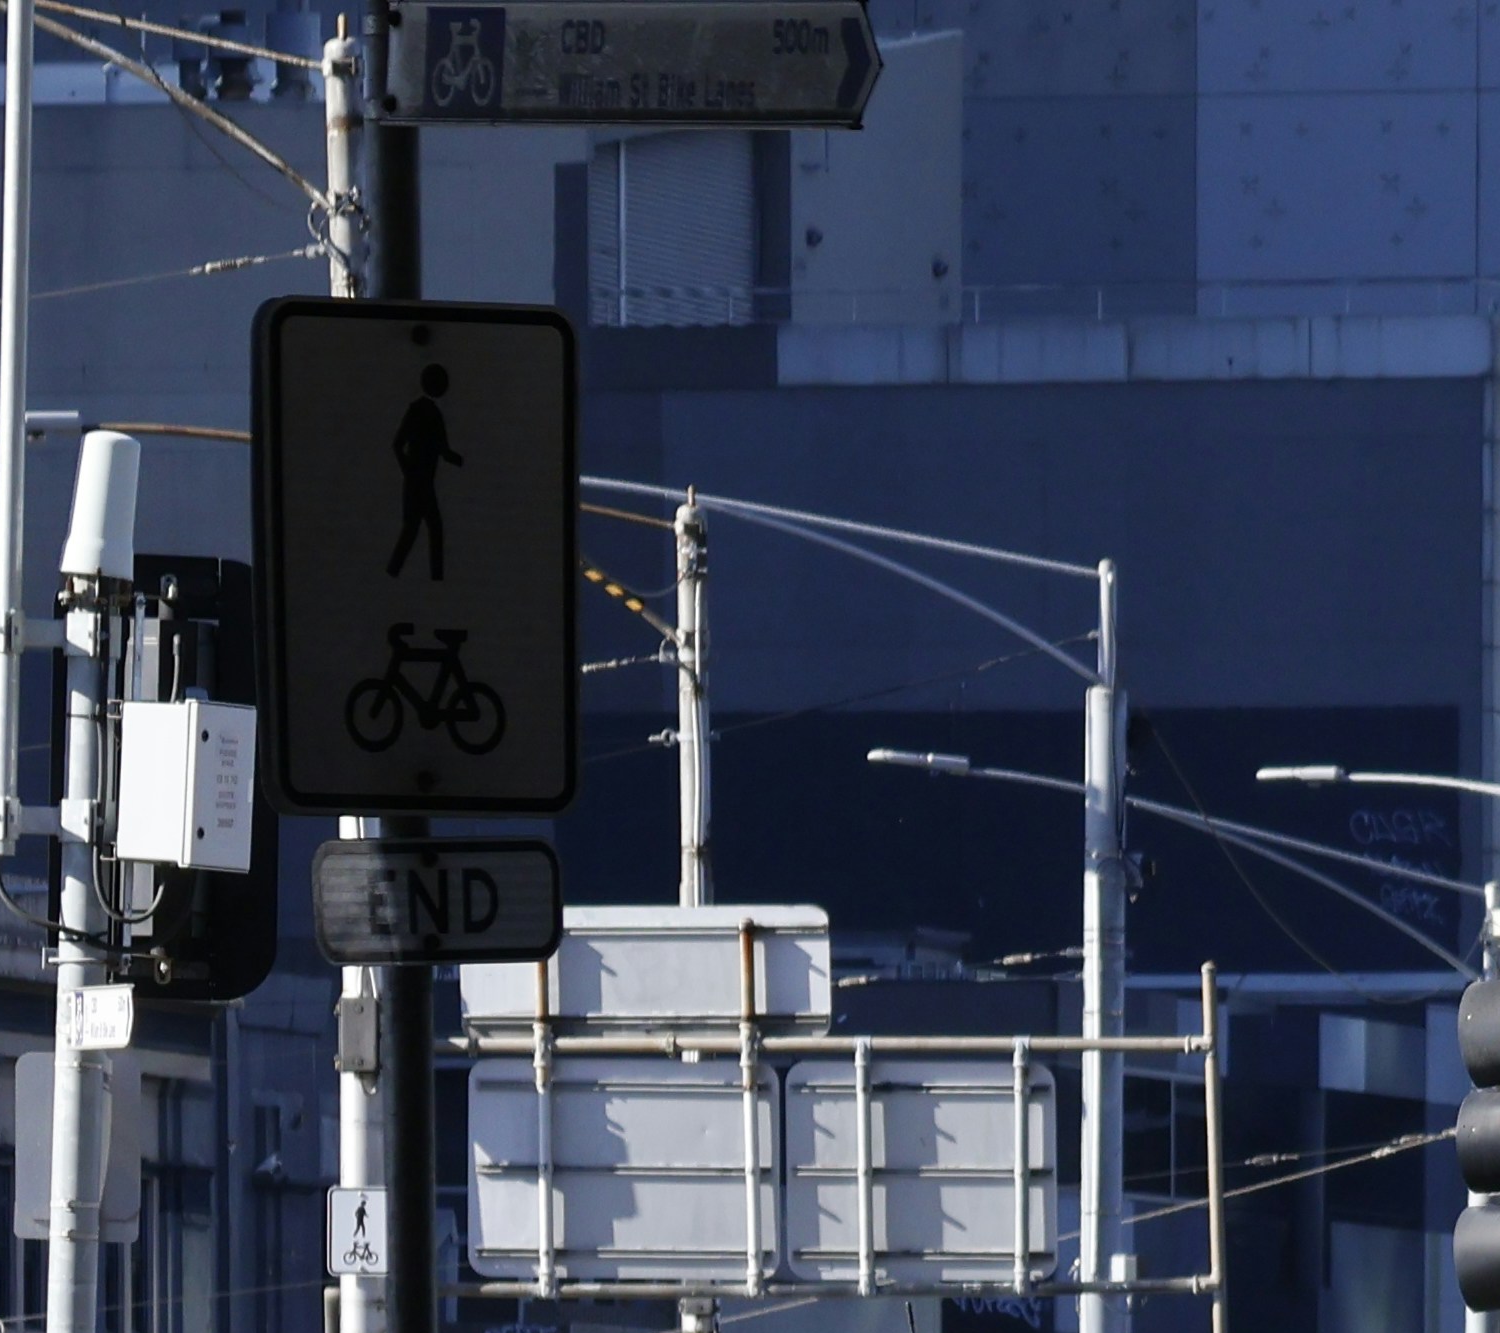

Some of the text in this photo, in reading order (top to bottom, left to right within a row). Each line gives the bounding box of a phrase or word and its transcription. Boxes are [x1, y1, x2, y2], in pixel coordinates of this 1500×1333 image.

[561, 20, 829, 55] CBD 500m
[630, 73, 645, 108] St
[367, 868, 499, 935] END
